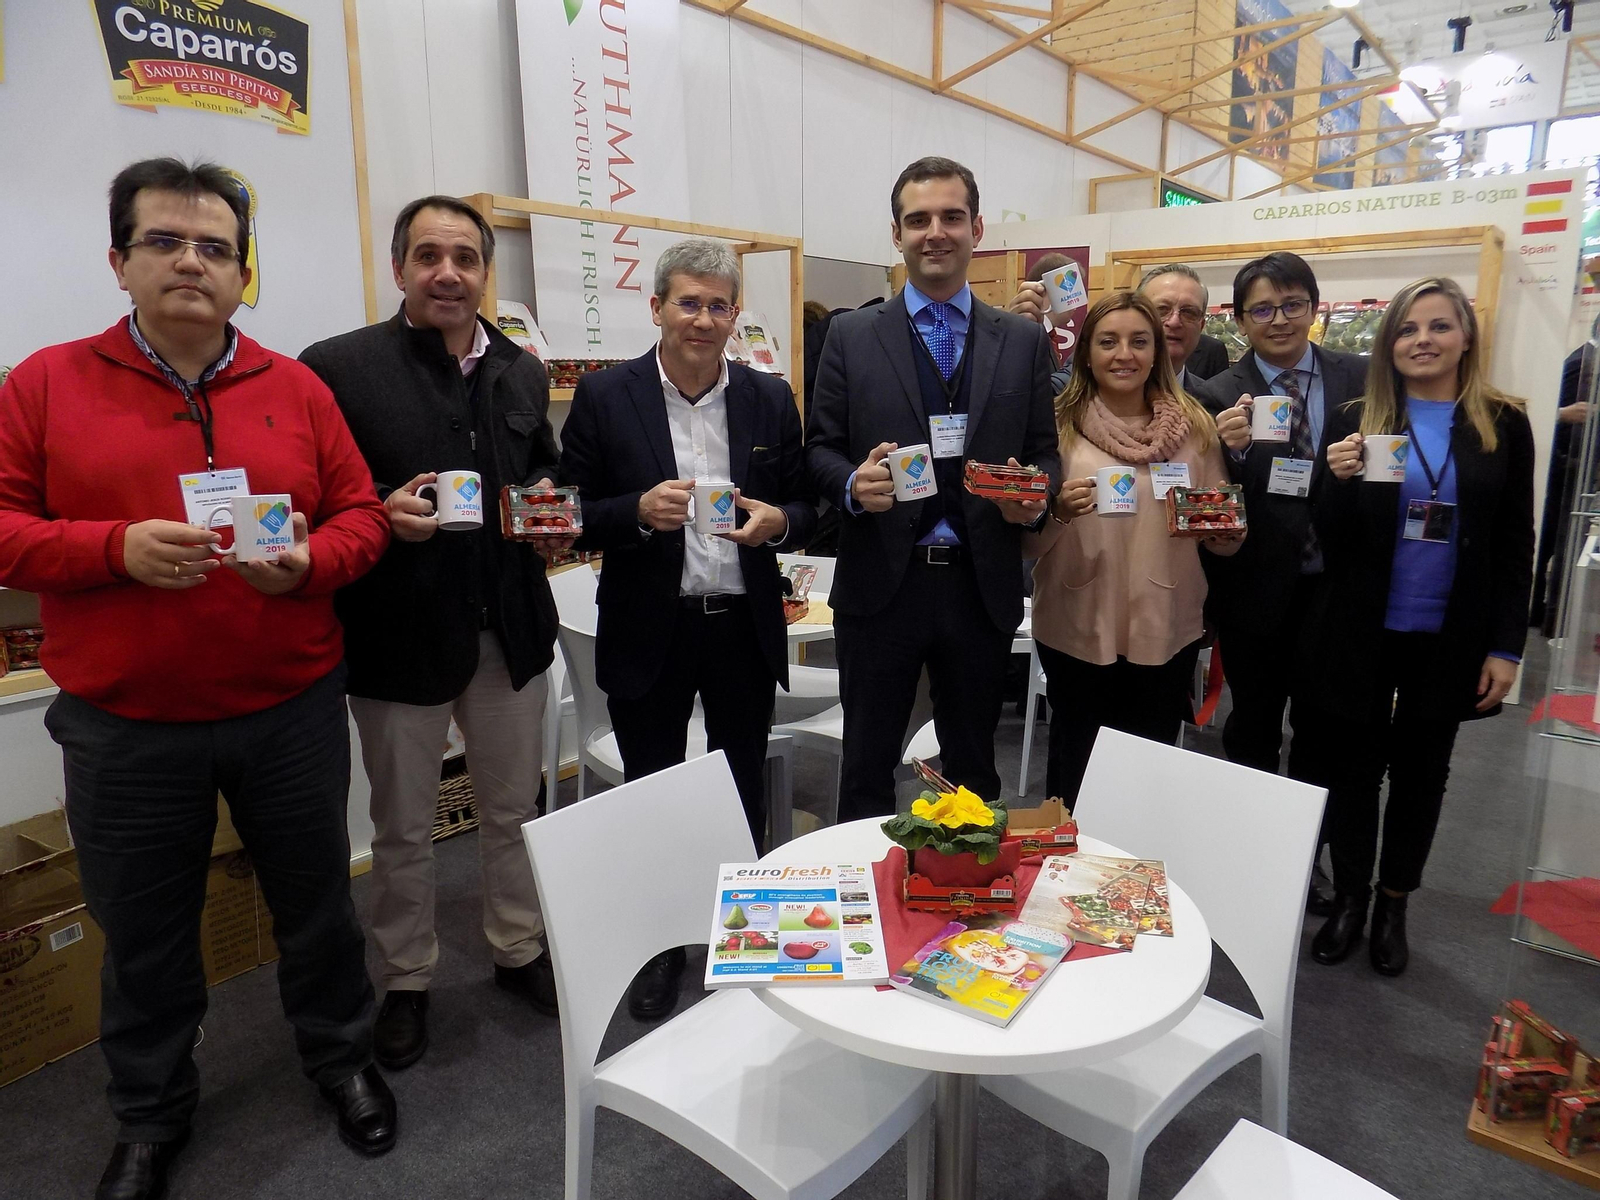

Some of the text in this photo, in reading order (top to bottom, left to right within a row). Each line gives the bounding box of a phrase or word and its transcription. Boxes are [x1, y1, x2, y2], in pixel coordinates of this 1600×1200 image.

[159, 0, 255, 37] PREMIUM
[114, 5, 298, 75] Caparrós
[144, 64, 279, 102] SANDÍA SIN PEPITAS
[181, 83, 252, 104] SEEDLESS
[1253, 187, 1518, 221] CAPARROS NATURE B-03m
[1520, 243, 1556, 257] Spain
[905, 478, 931, 490] ALMERÍA
[912, 486, 928, 495] 2019
[461, 509, 477, 517] 2019
[716, 522, 730, 530] 2019
[256, 535, 291, 546] ALMERÍA
[265, 544, 286, 554] 2019
[736, 865, 833, 880] eurofresh
[929, 948, 982, 973] FRUIT
[916, 965, 957, 987] TICA
[920, 957, 976, 983] LOGIS
[57, 1004, 74, 1016] KGS
[54, 1016, 71, 1028] KGS
